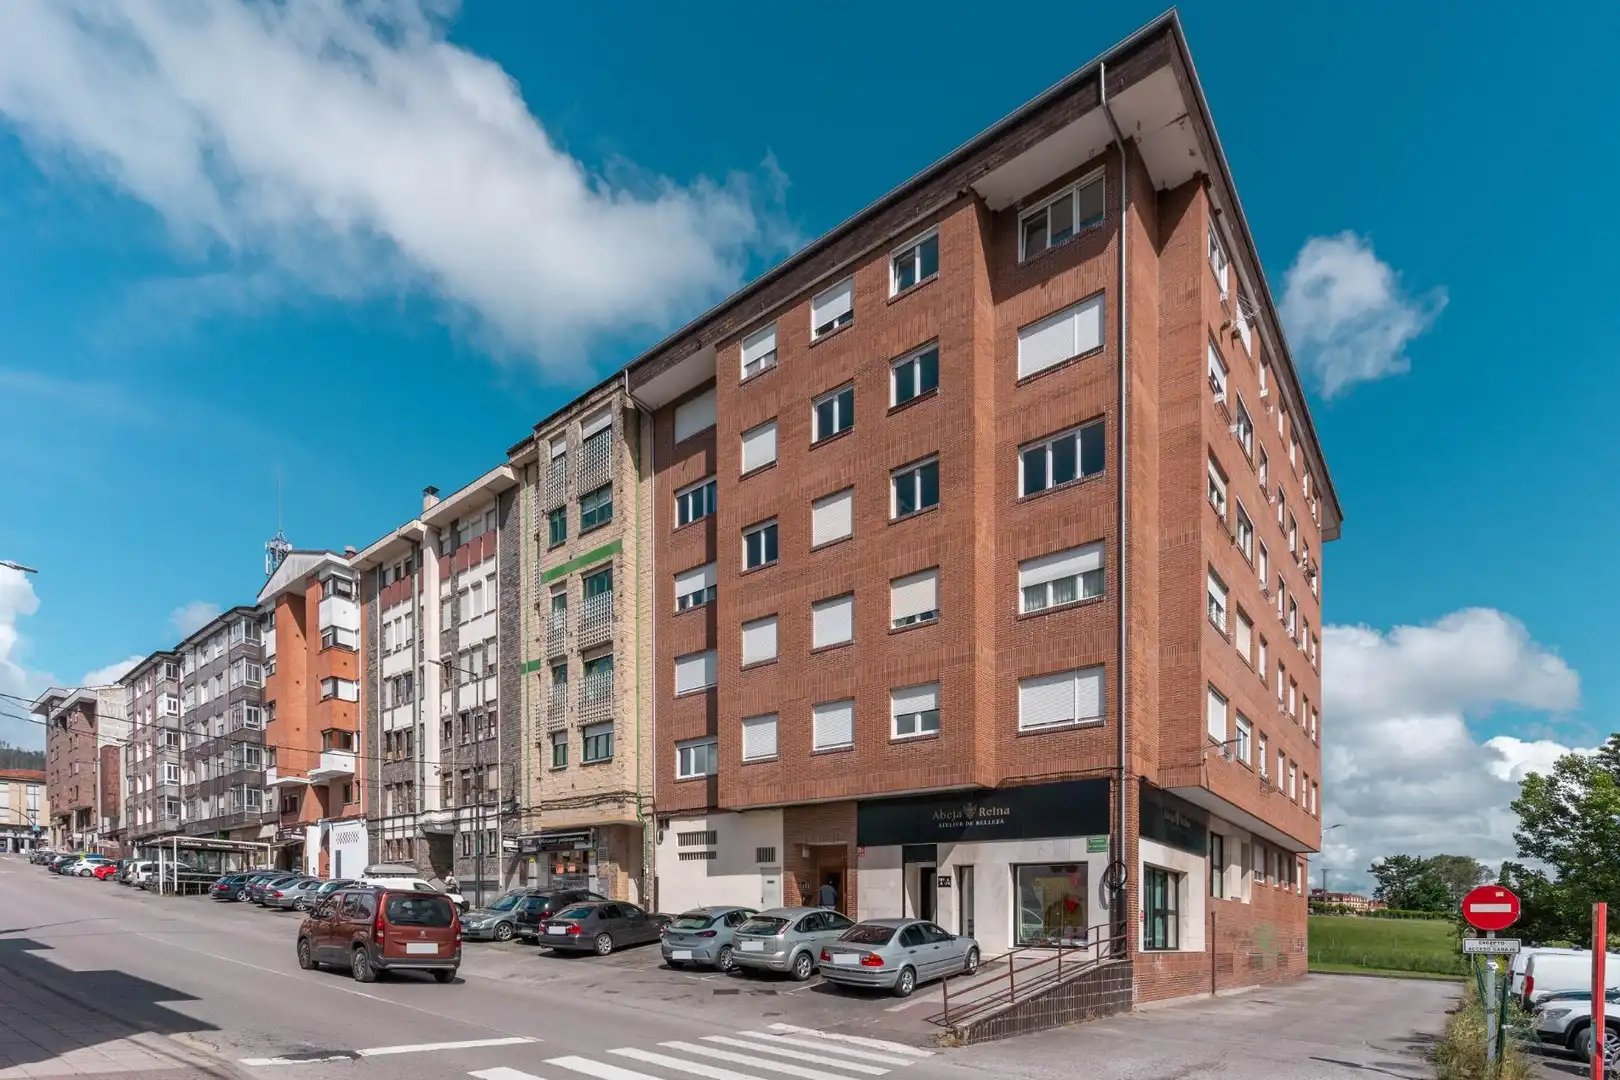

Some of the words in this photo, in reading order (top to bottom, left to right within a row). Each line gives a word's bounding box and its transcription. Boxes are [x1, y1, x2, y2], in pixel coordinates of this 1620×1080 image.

[932, 809, 962, 821] Abeja
[979, 806, 1010, 817] Reina
[975, 818, 1005, 826] BELLEZA
